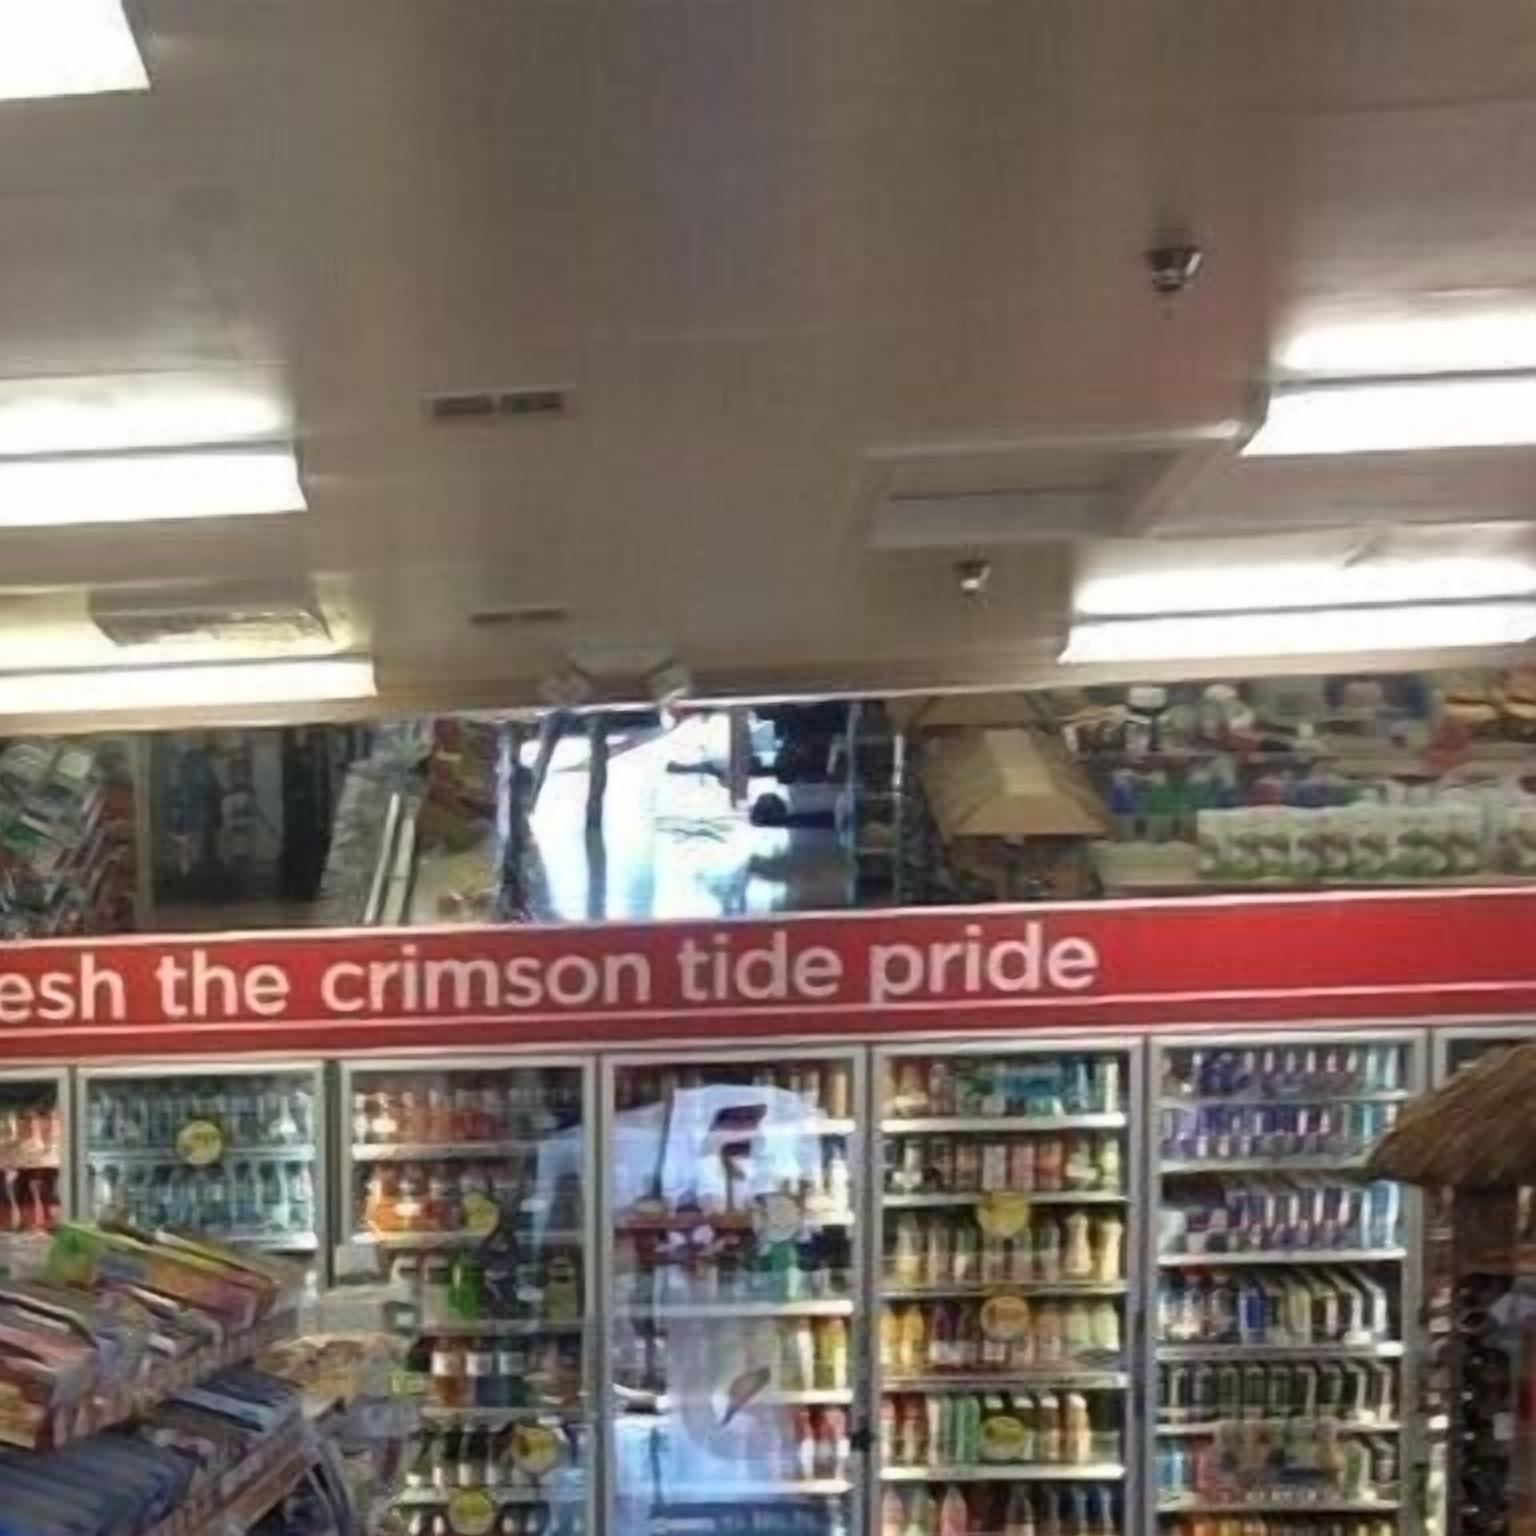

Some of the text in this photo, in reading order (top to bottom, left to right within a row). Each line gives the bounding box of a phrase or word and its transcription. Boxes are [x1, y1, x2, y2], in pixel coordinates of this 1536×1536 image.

[156, 949, 291, 1017] the
[321, 943, 652, 1013] crimson
[677, 931, 843, 1002] tide
[870, 921, 1098, 1006] pride
